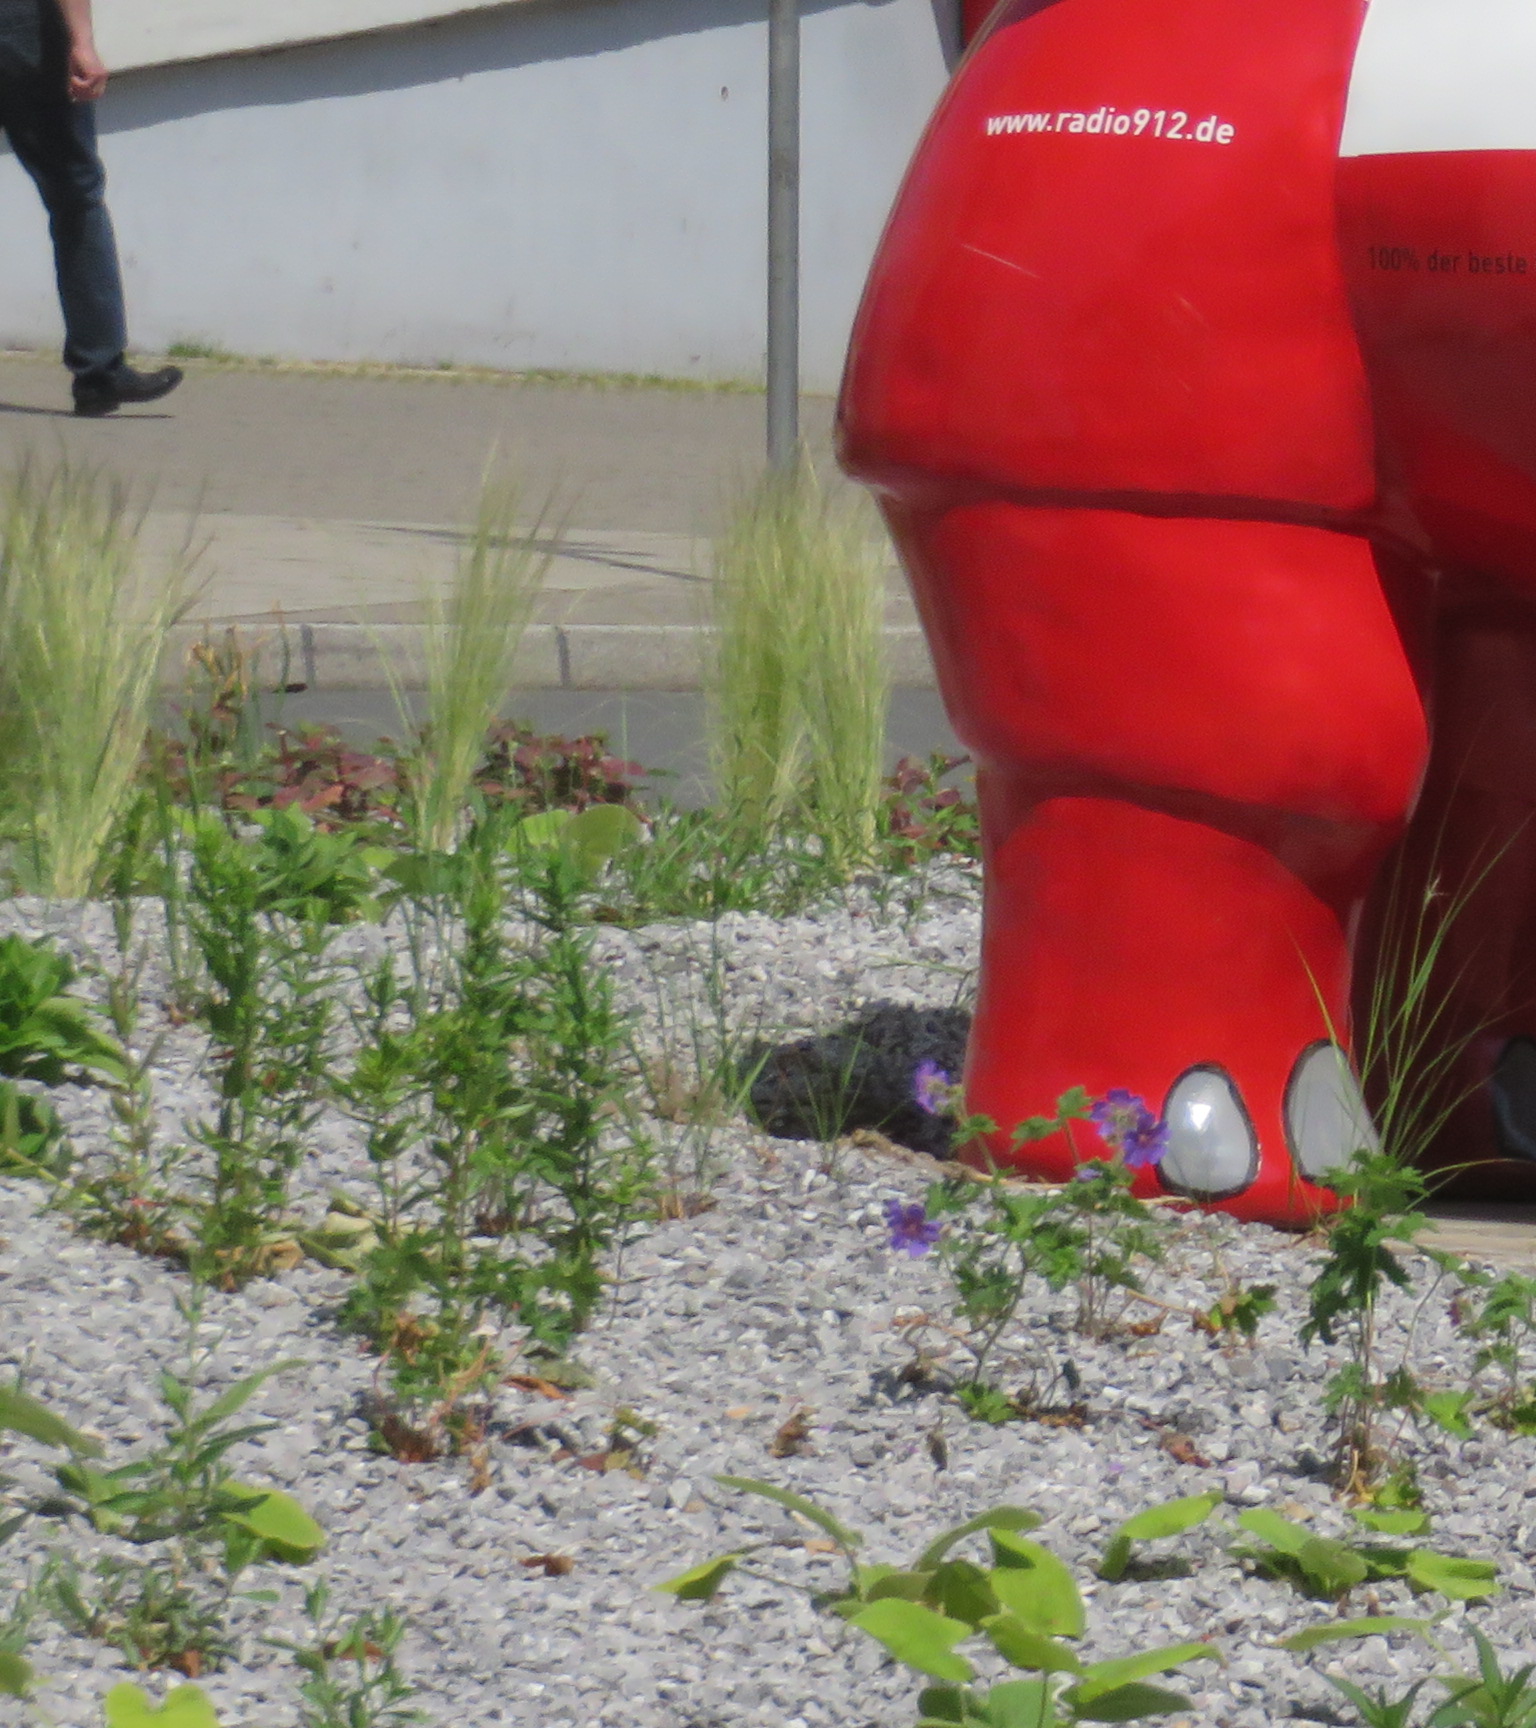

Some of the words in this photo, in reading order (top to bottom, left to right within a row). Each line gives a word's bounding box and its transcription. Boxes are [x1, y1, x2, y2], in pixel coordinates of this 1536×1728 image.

[986, 106, 1235, 145] www.radio912.de
[1366, 246, 1419, 271] 100%
[1426, 250, 1460, 272] der
[1468, 251, 1527, 275] beste
